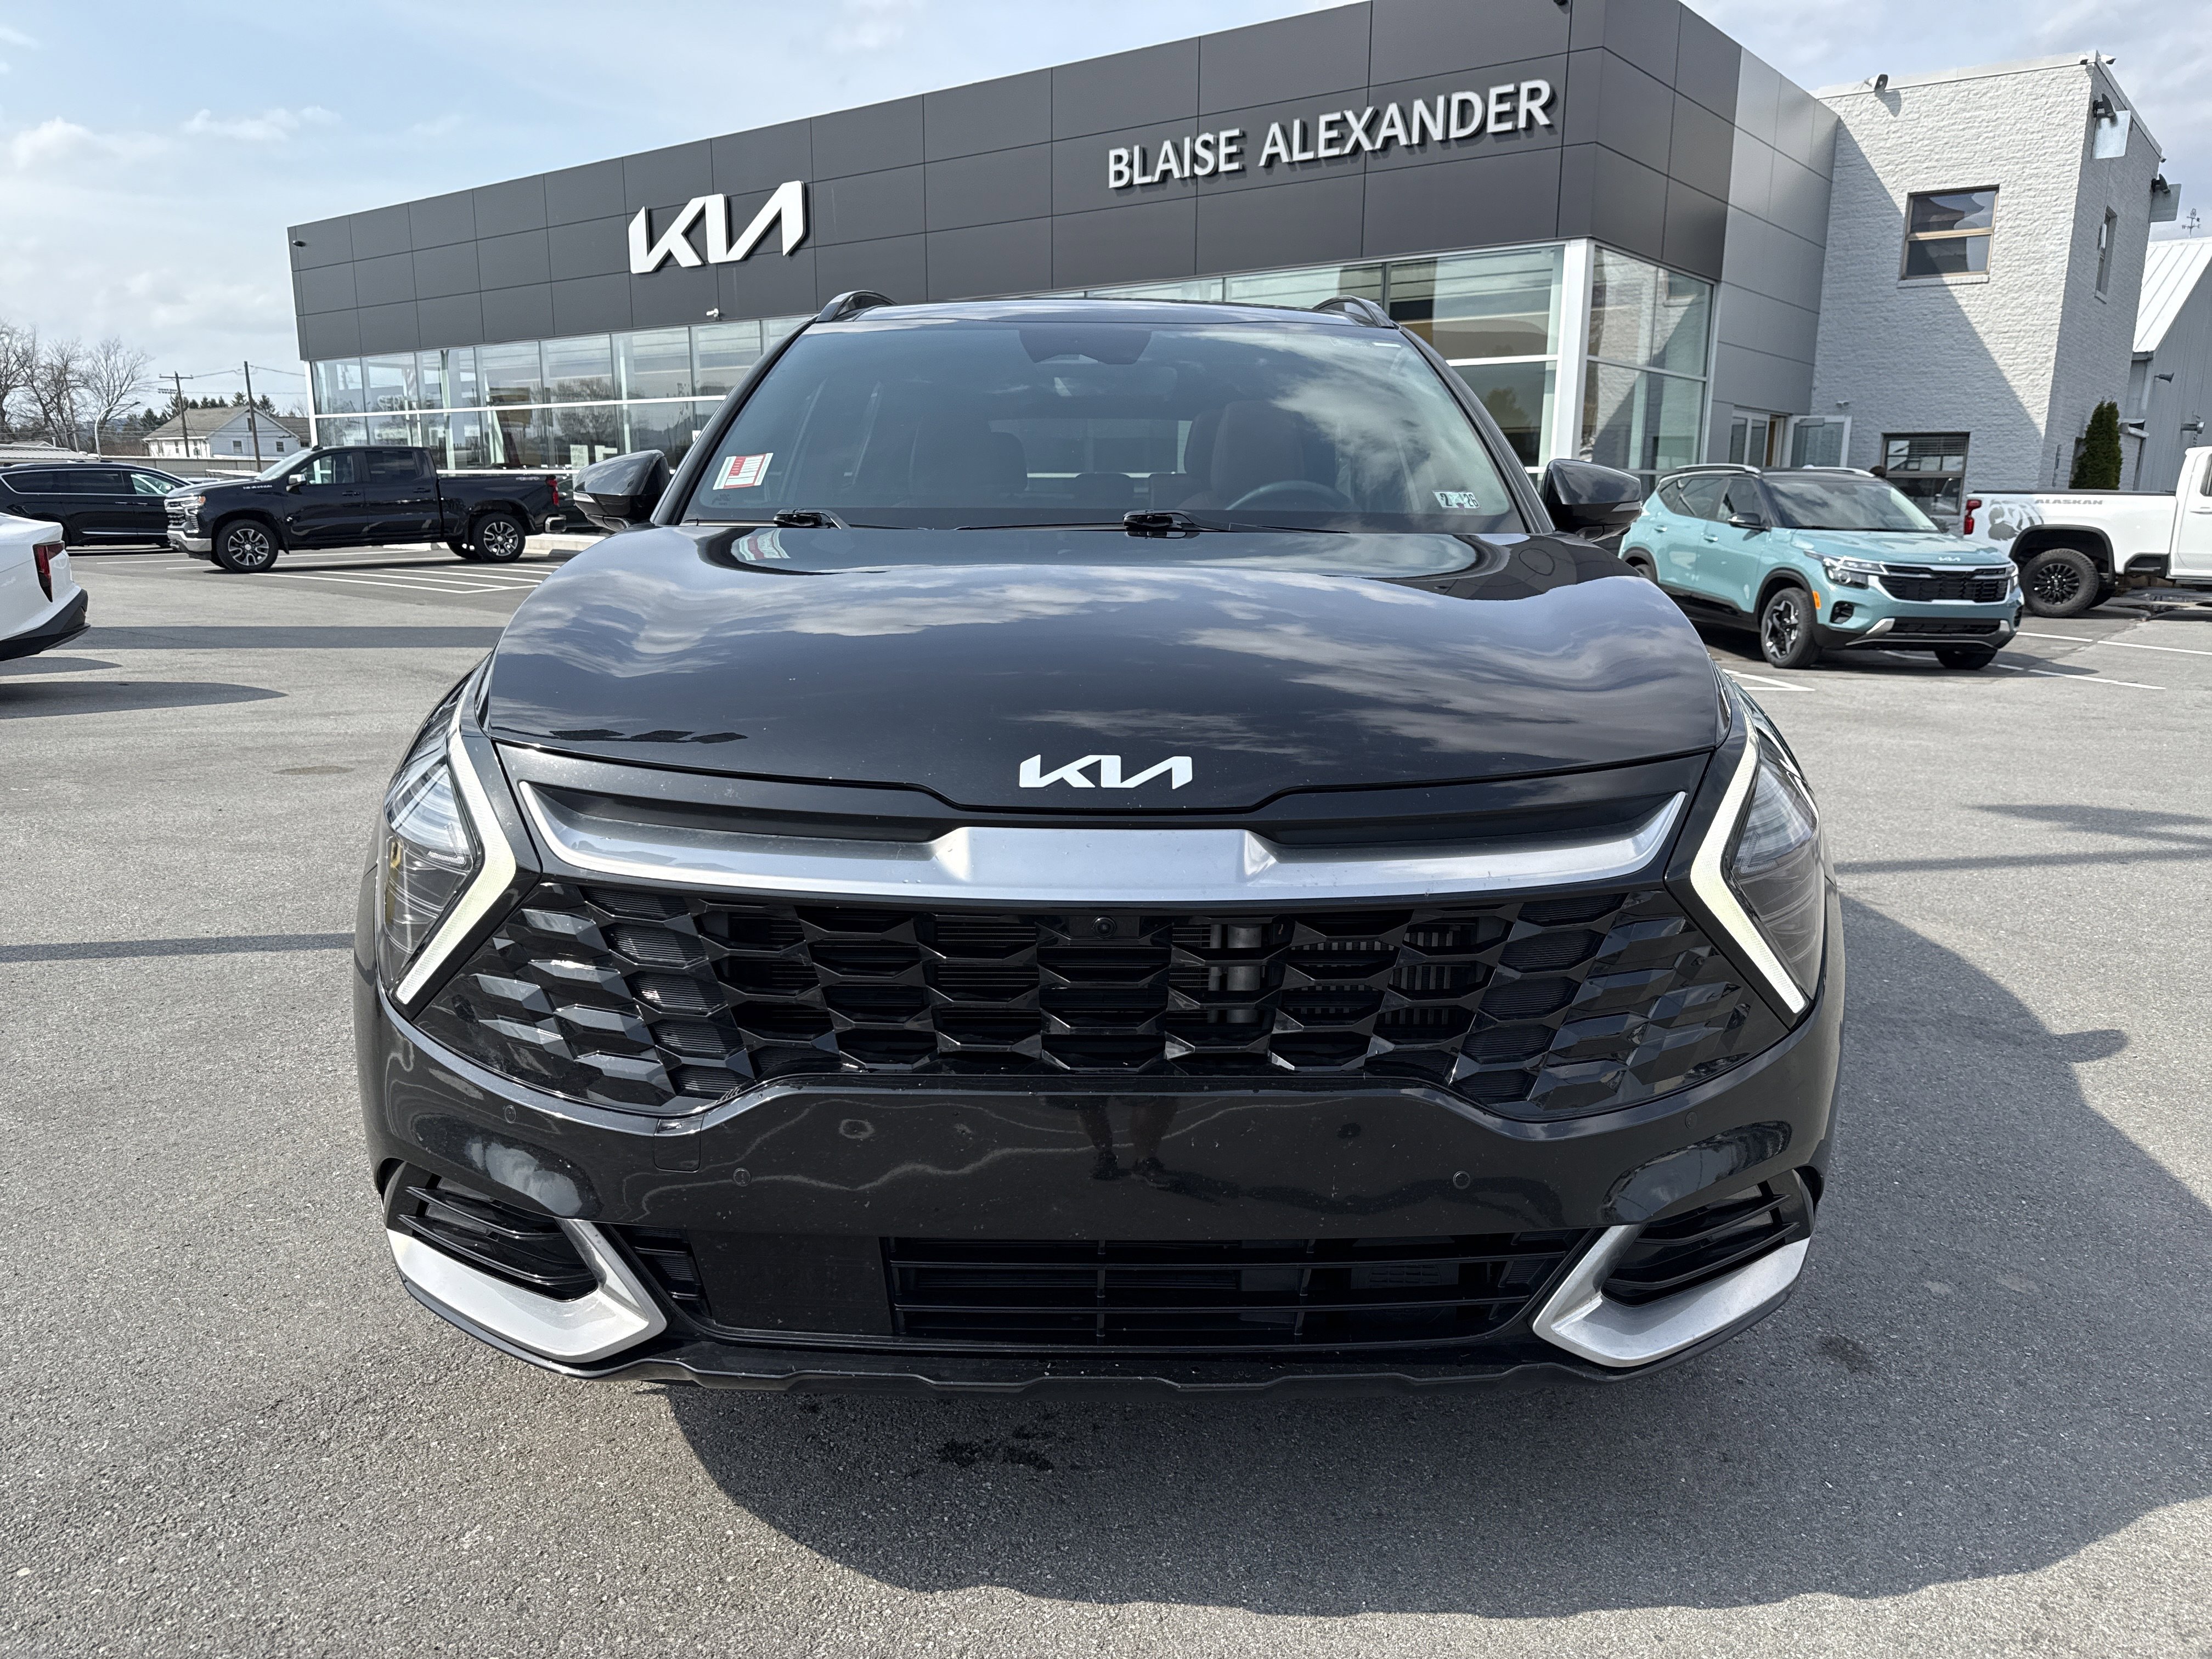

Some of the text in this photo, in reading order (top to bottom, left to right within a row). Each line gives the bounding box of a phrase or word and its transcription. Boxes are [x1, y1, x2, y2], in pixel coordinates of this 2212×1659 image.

[1108, 79, 1554, 189] BLAISE ALEXANDER
[628, 180, 805, 274] KIA
[1019, 754, 1193, 790] KIA
